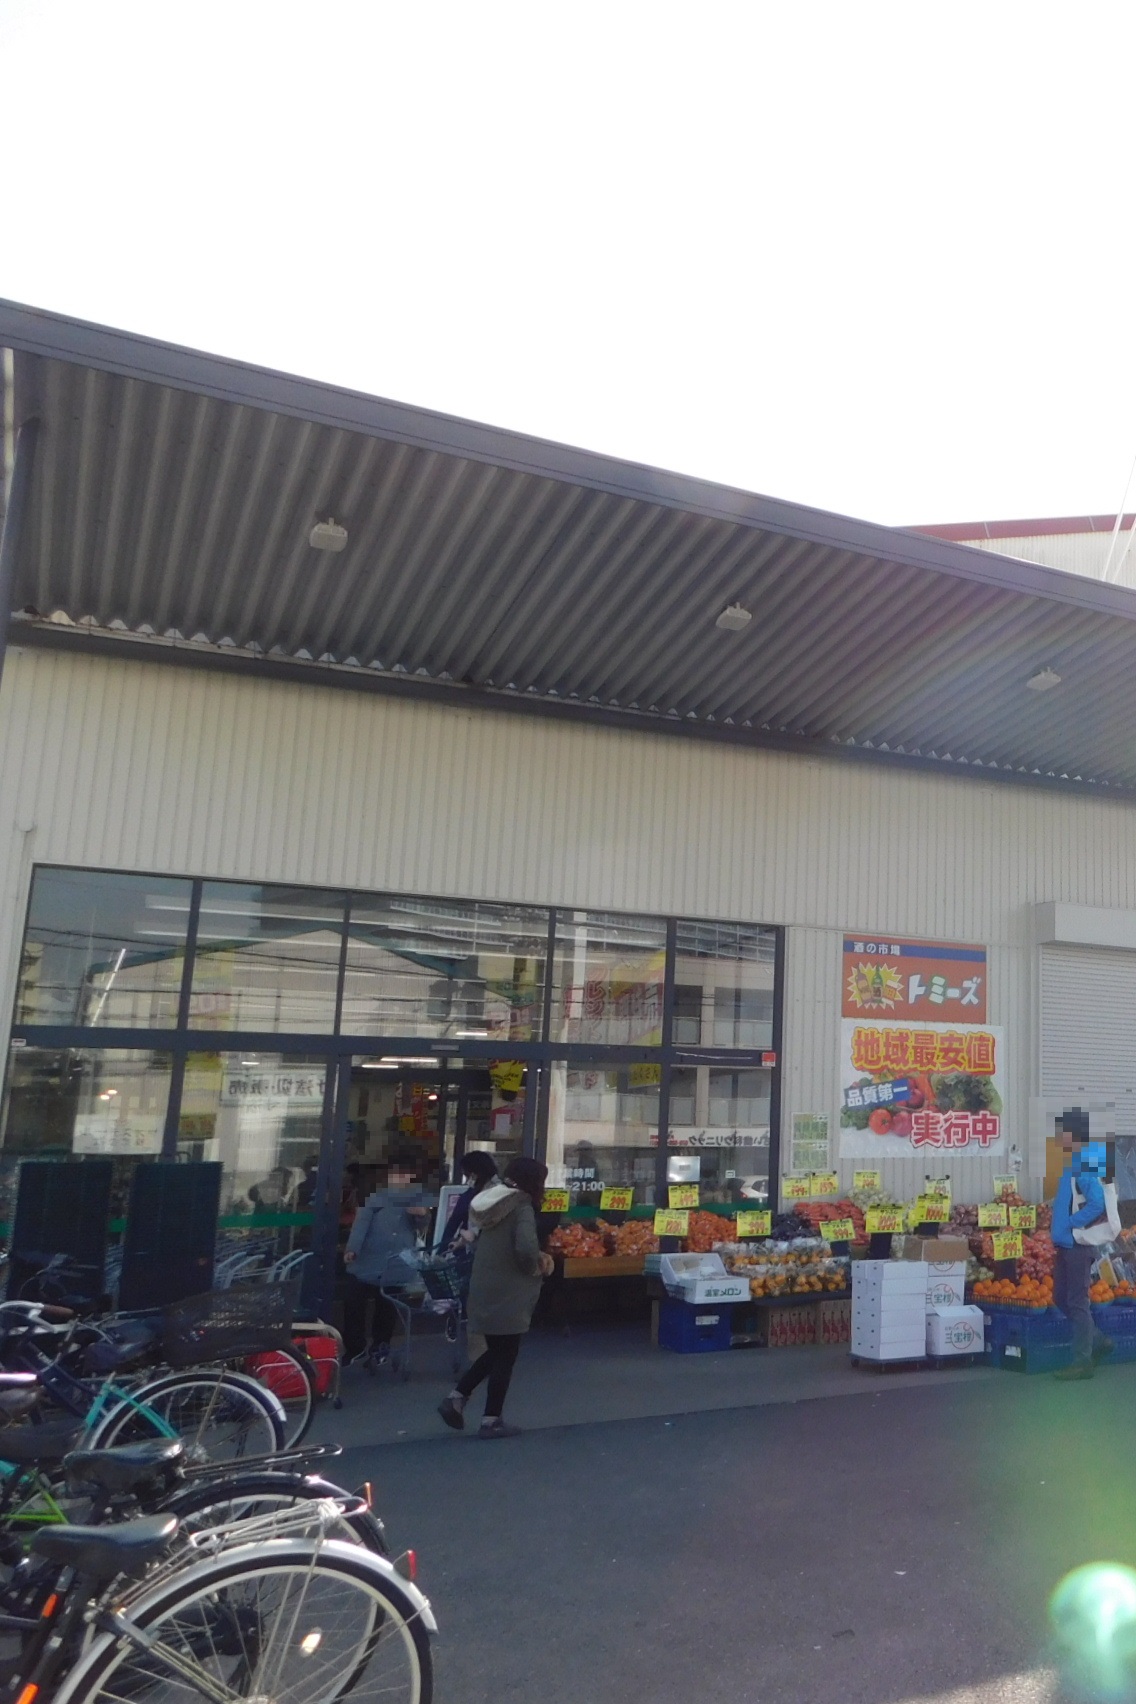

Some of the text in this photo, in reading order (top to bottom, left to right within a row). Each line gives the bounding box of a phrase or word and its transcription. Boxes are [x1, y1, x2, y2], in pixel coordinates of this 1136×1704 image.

[853, 941, 900, 956] 酒の市場
[908, 974, 982, 1005] トミーズ
[851, 1026, 996, 1076] 地域最安値
[846, 1081, 908, 1107] 品質第一
[911, 1109, 1000, 1148] 実行中
